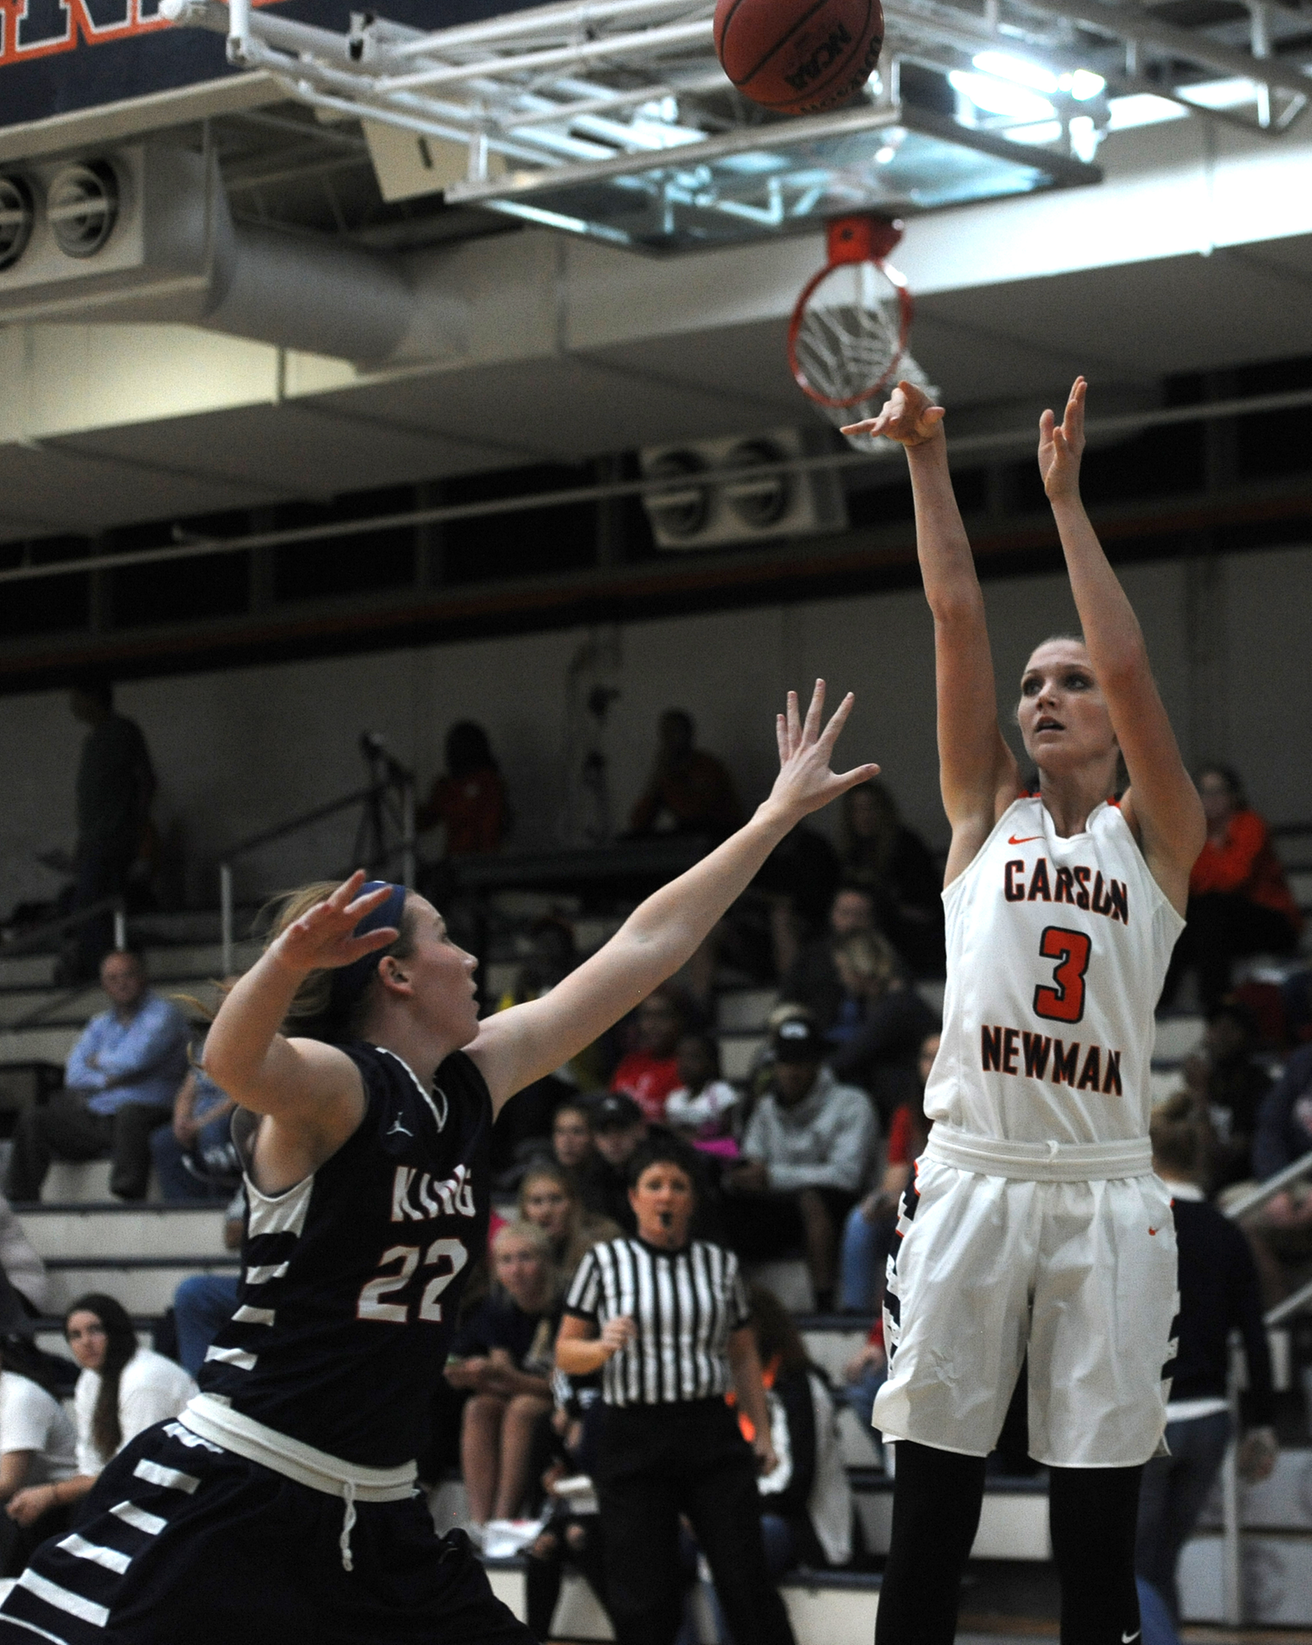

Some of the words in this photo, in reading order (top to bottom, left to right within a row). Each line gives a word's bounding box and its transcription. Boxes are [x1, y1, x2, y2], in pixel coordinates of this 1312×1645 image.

[784, 23, 852, 91] NCAA
[1004, 857, 1129, 925] CARSON
[1033, 925, 1092, 1025] 3
[981, 1024, 1123, 1097] NEWMAN
[356, 1238, 468, 1323] 22
